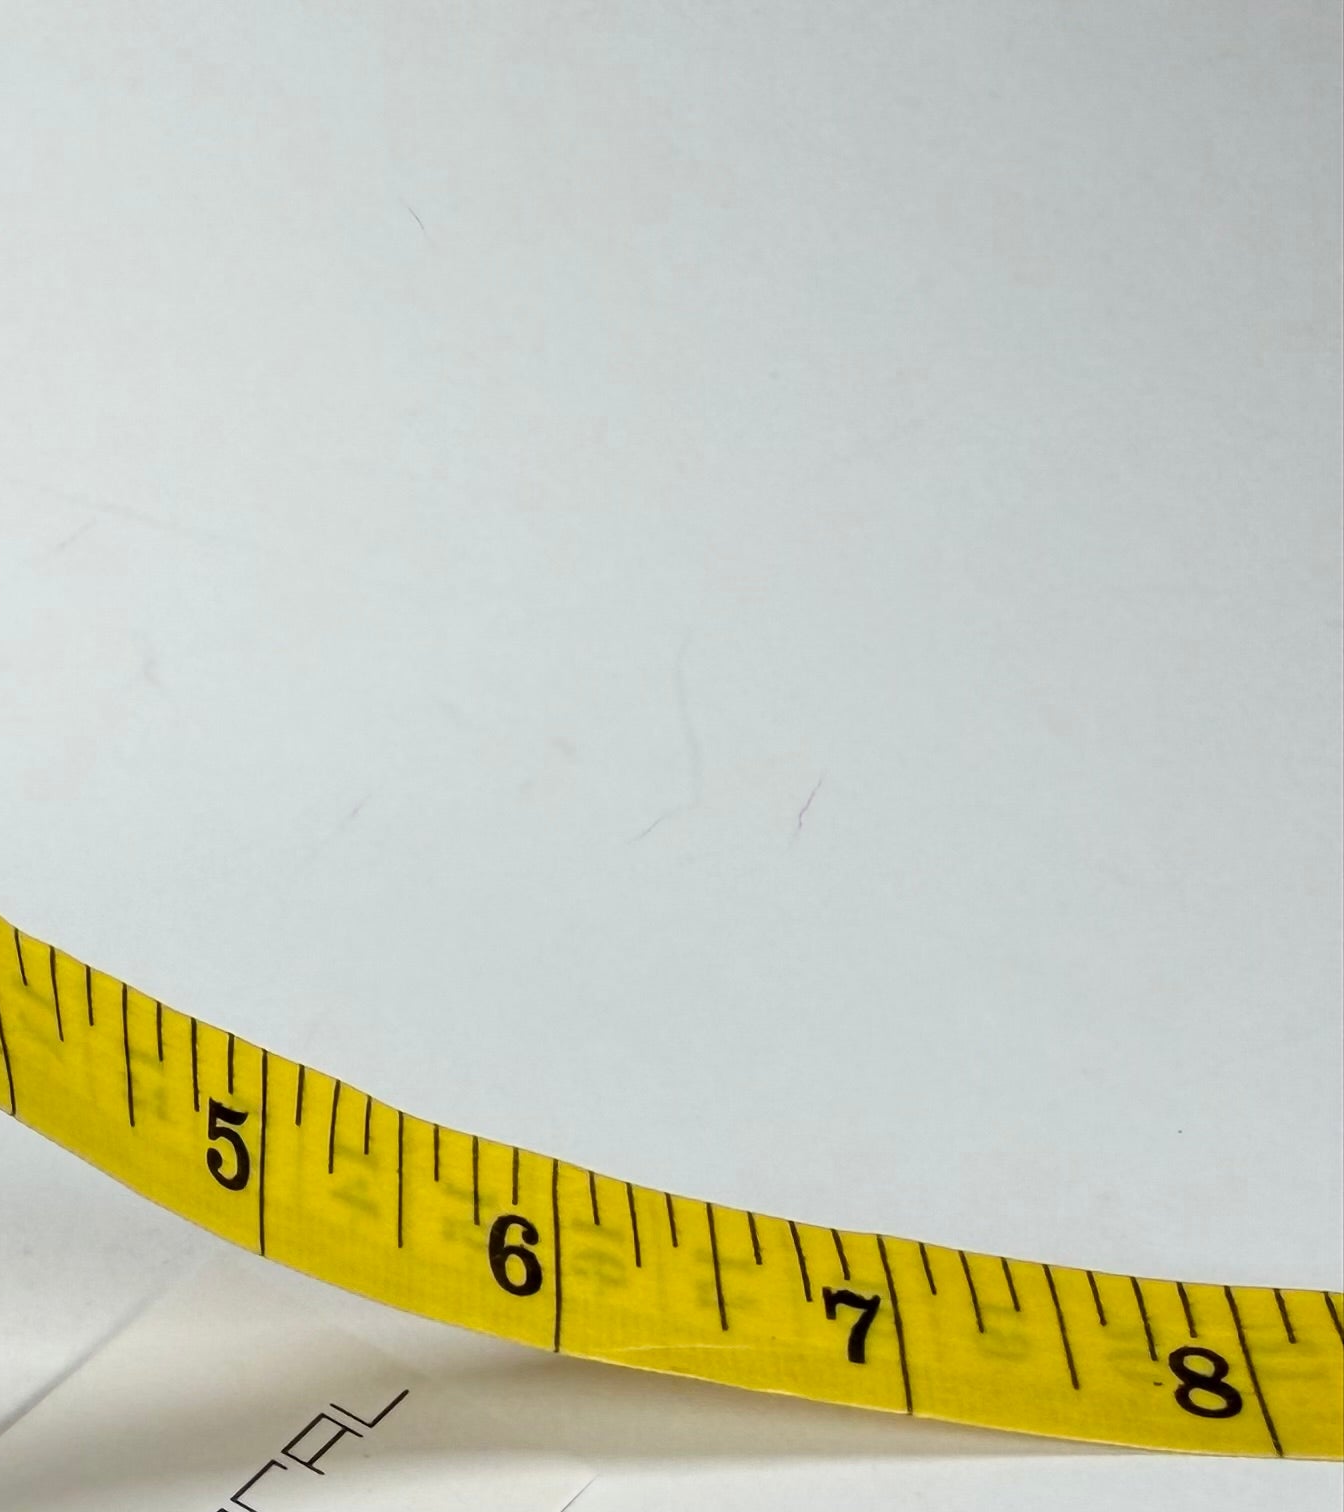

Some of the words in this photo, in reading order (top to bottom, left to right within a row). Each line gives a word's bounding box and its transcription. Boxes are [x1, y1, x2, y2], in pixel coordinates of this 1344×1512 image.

[206, 1096, 250, 1191] 5
[488, 1214, 543, 1297] 6
[822, 1286, 881, 1364] 7
[1168, 1346, 1244, 1419] 8
